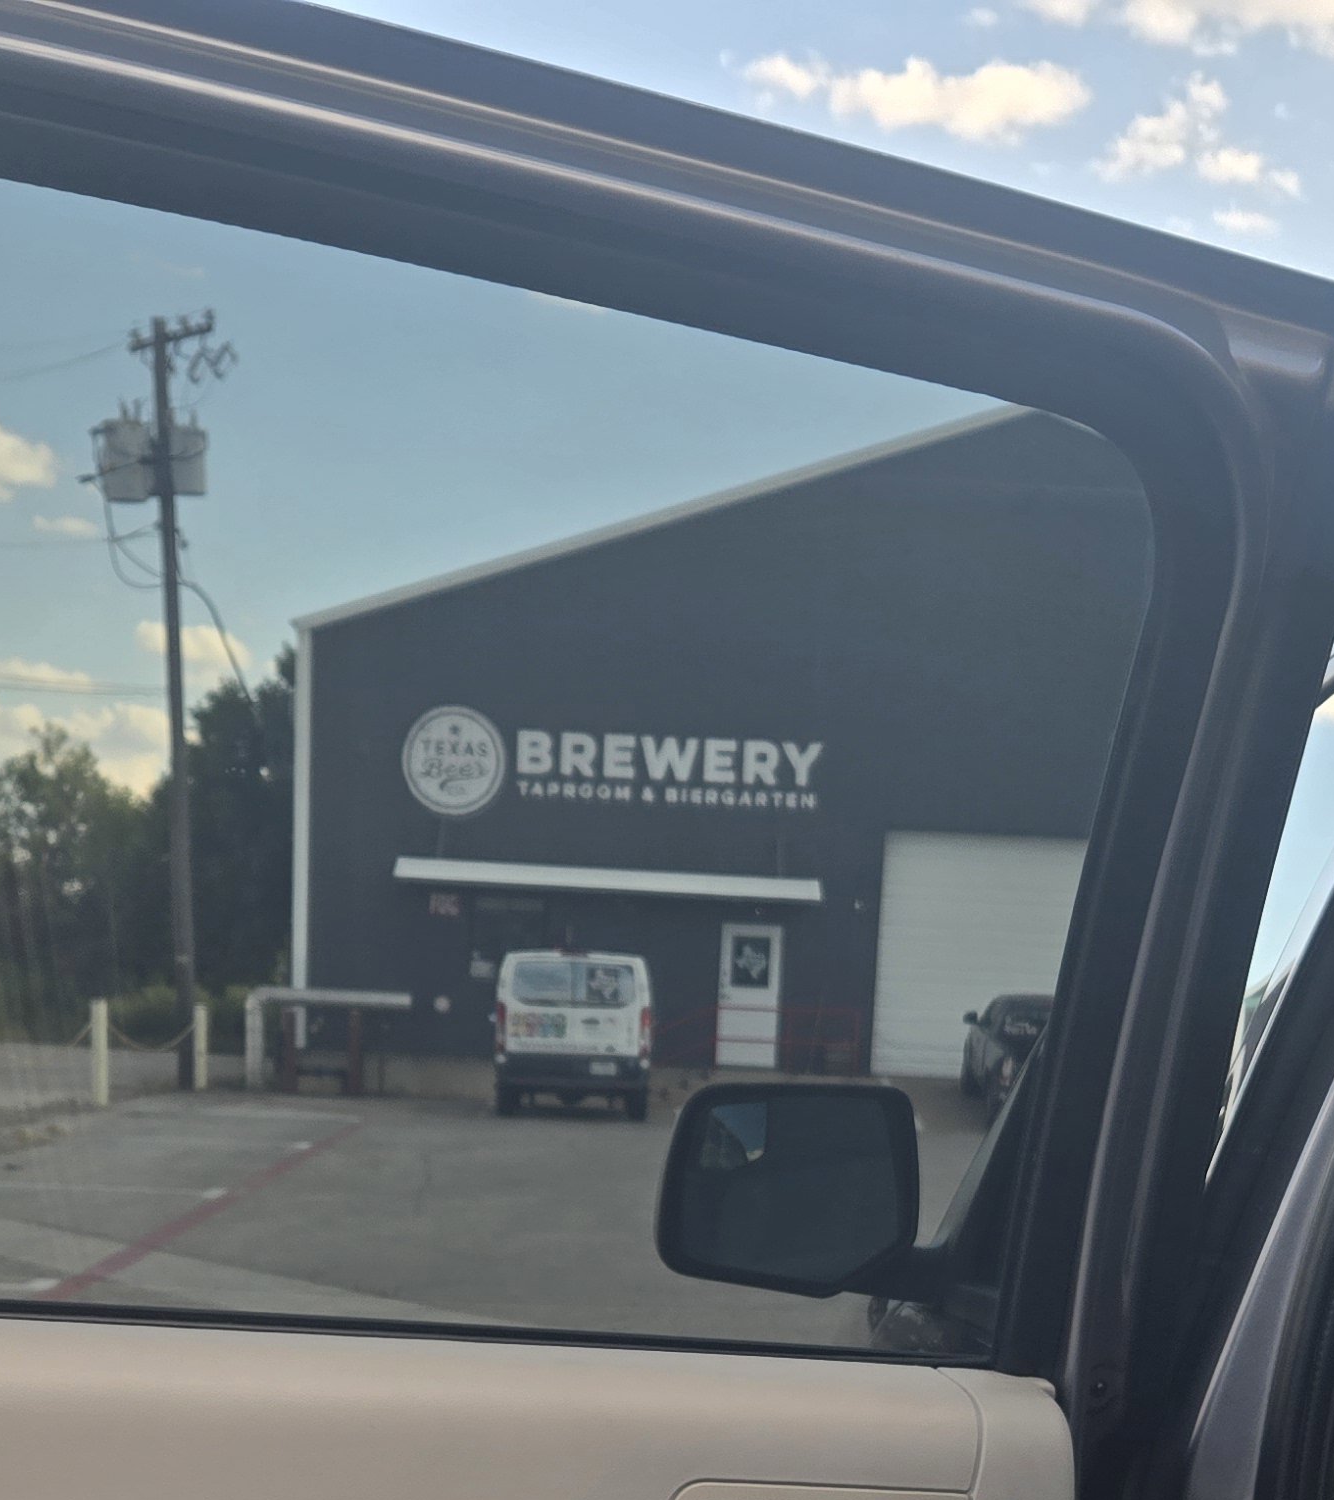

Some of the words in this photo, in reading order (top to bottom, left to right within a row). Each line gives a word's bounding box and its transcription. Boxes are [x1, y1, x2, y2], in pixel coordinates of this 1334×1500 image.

[420, 739, 488, 757] TEXAS
[517, 729, 823, 787] BREWERY
[517, 780, 630, 801] TAPROOM
[641, 785, 653, 804] &
[665, 787, 816, 809] BIERGARTEN
